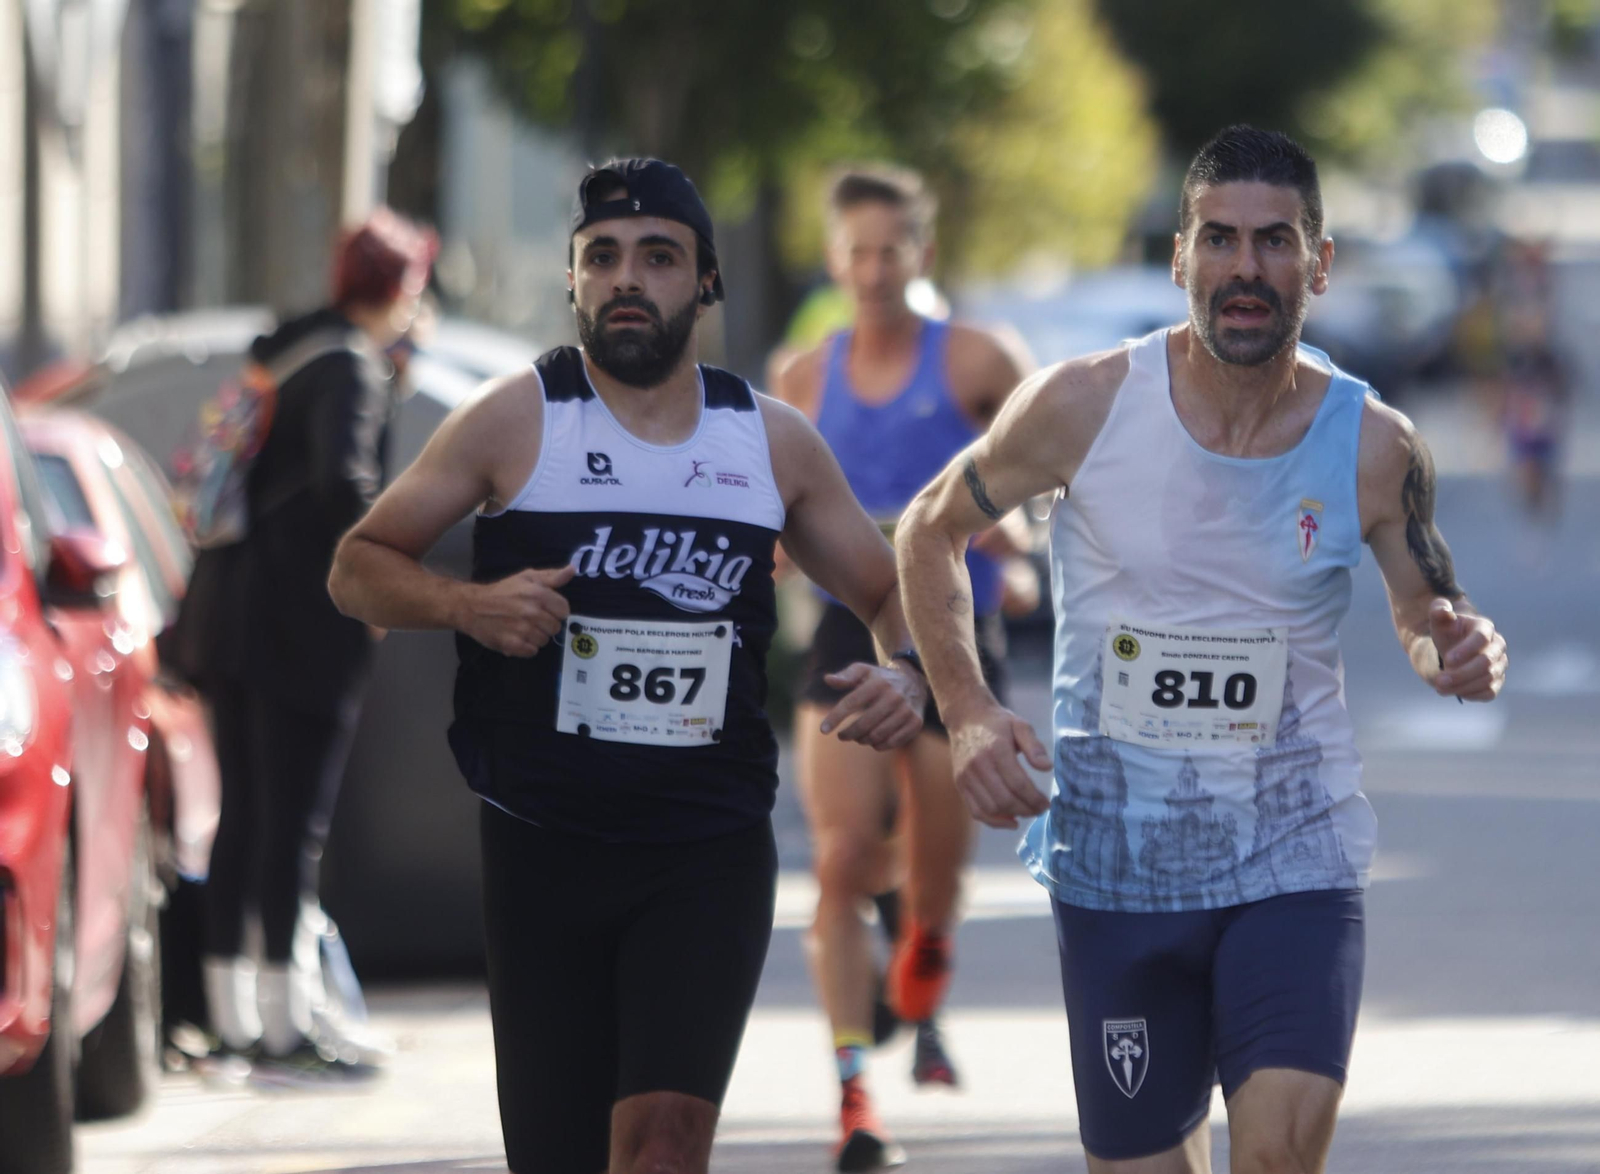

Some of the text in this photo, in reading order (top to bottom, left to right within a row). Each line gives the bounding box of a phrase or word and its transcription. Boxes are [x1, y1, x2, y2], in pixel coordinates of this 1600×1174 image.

[717, 477, 750, 489] DELIKIA
[570, 526, 753, 593] delikia
[671, 583, 716, 602] fresh
[625, 629, 645, 637] POLA
[647, 630, 690, 638] ESCLEROSE
[1169, 634, 1190, 642] POLA
[1192, 635, 1239, 644] ESCLEROSE
[610, 663, 706, 706] 867
[1152, 670, 1257, 710] 810
[1107, 1022, 1143, 1031] COMPOSTELA
